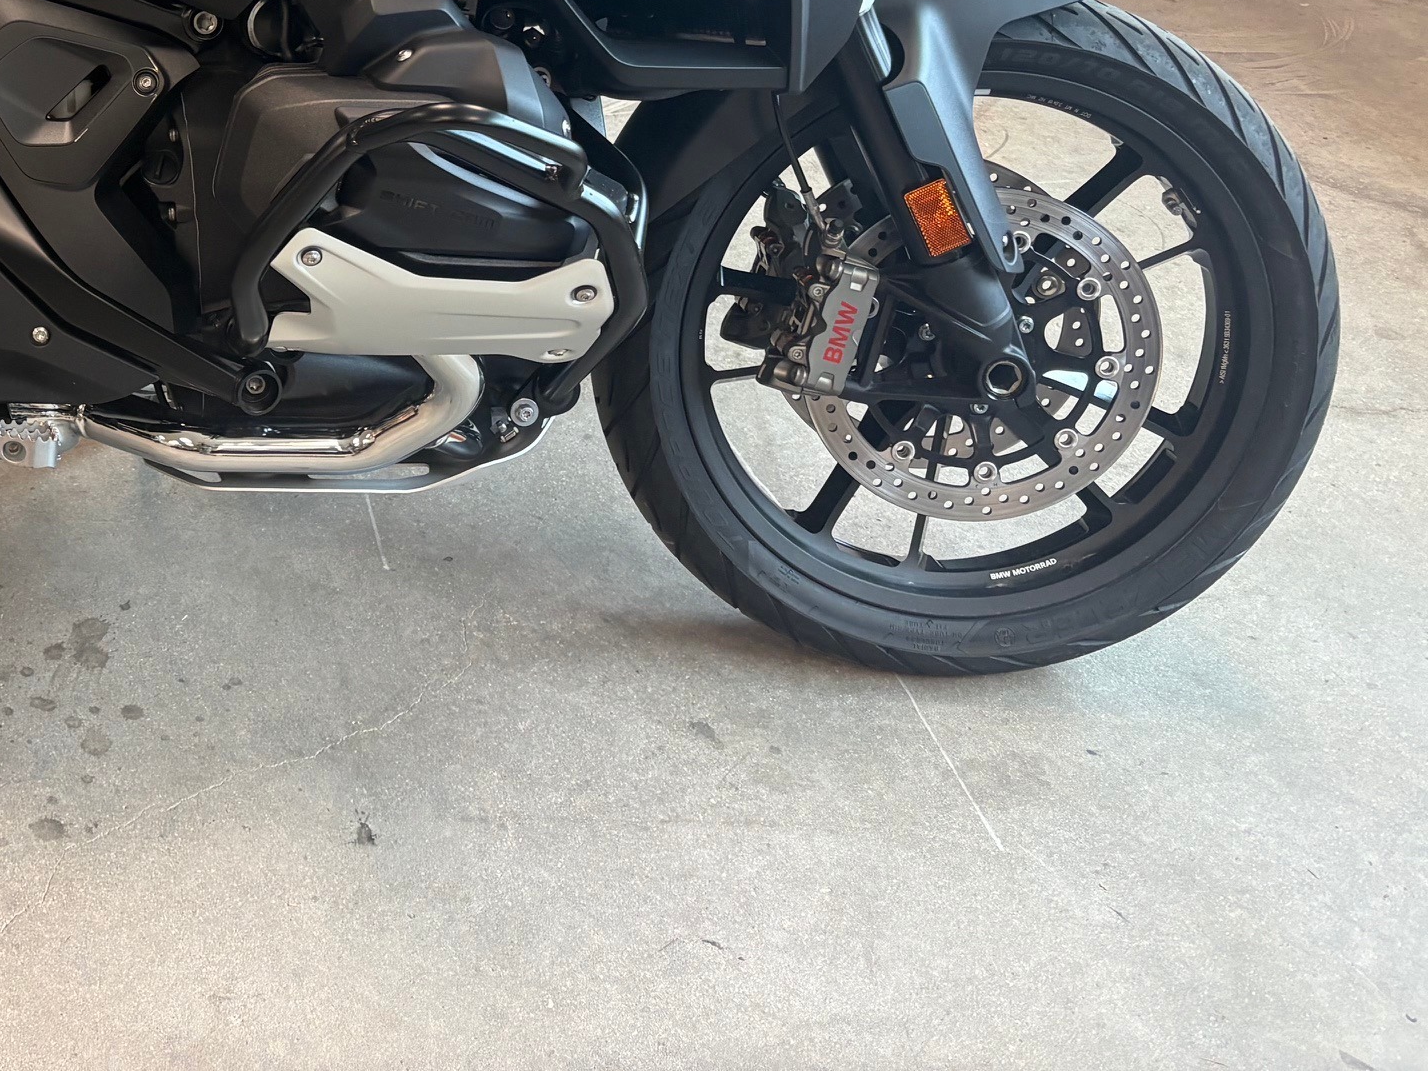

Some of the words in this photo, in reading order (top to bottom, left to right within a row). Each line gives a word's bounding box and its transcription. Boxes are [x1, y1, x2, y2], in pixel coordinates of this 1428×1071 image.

[823, 301, 858, 364] BMW
[990, 570, 1011, 581] BMW
[1012, 557, 1058, 577] MOTORRAD
